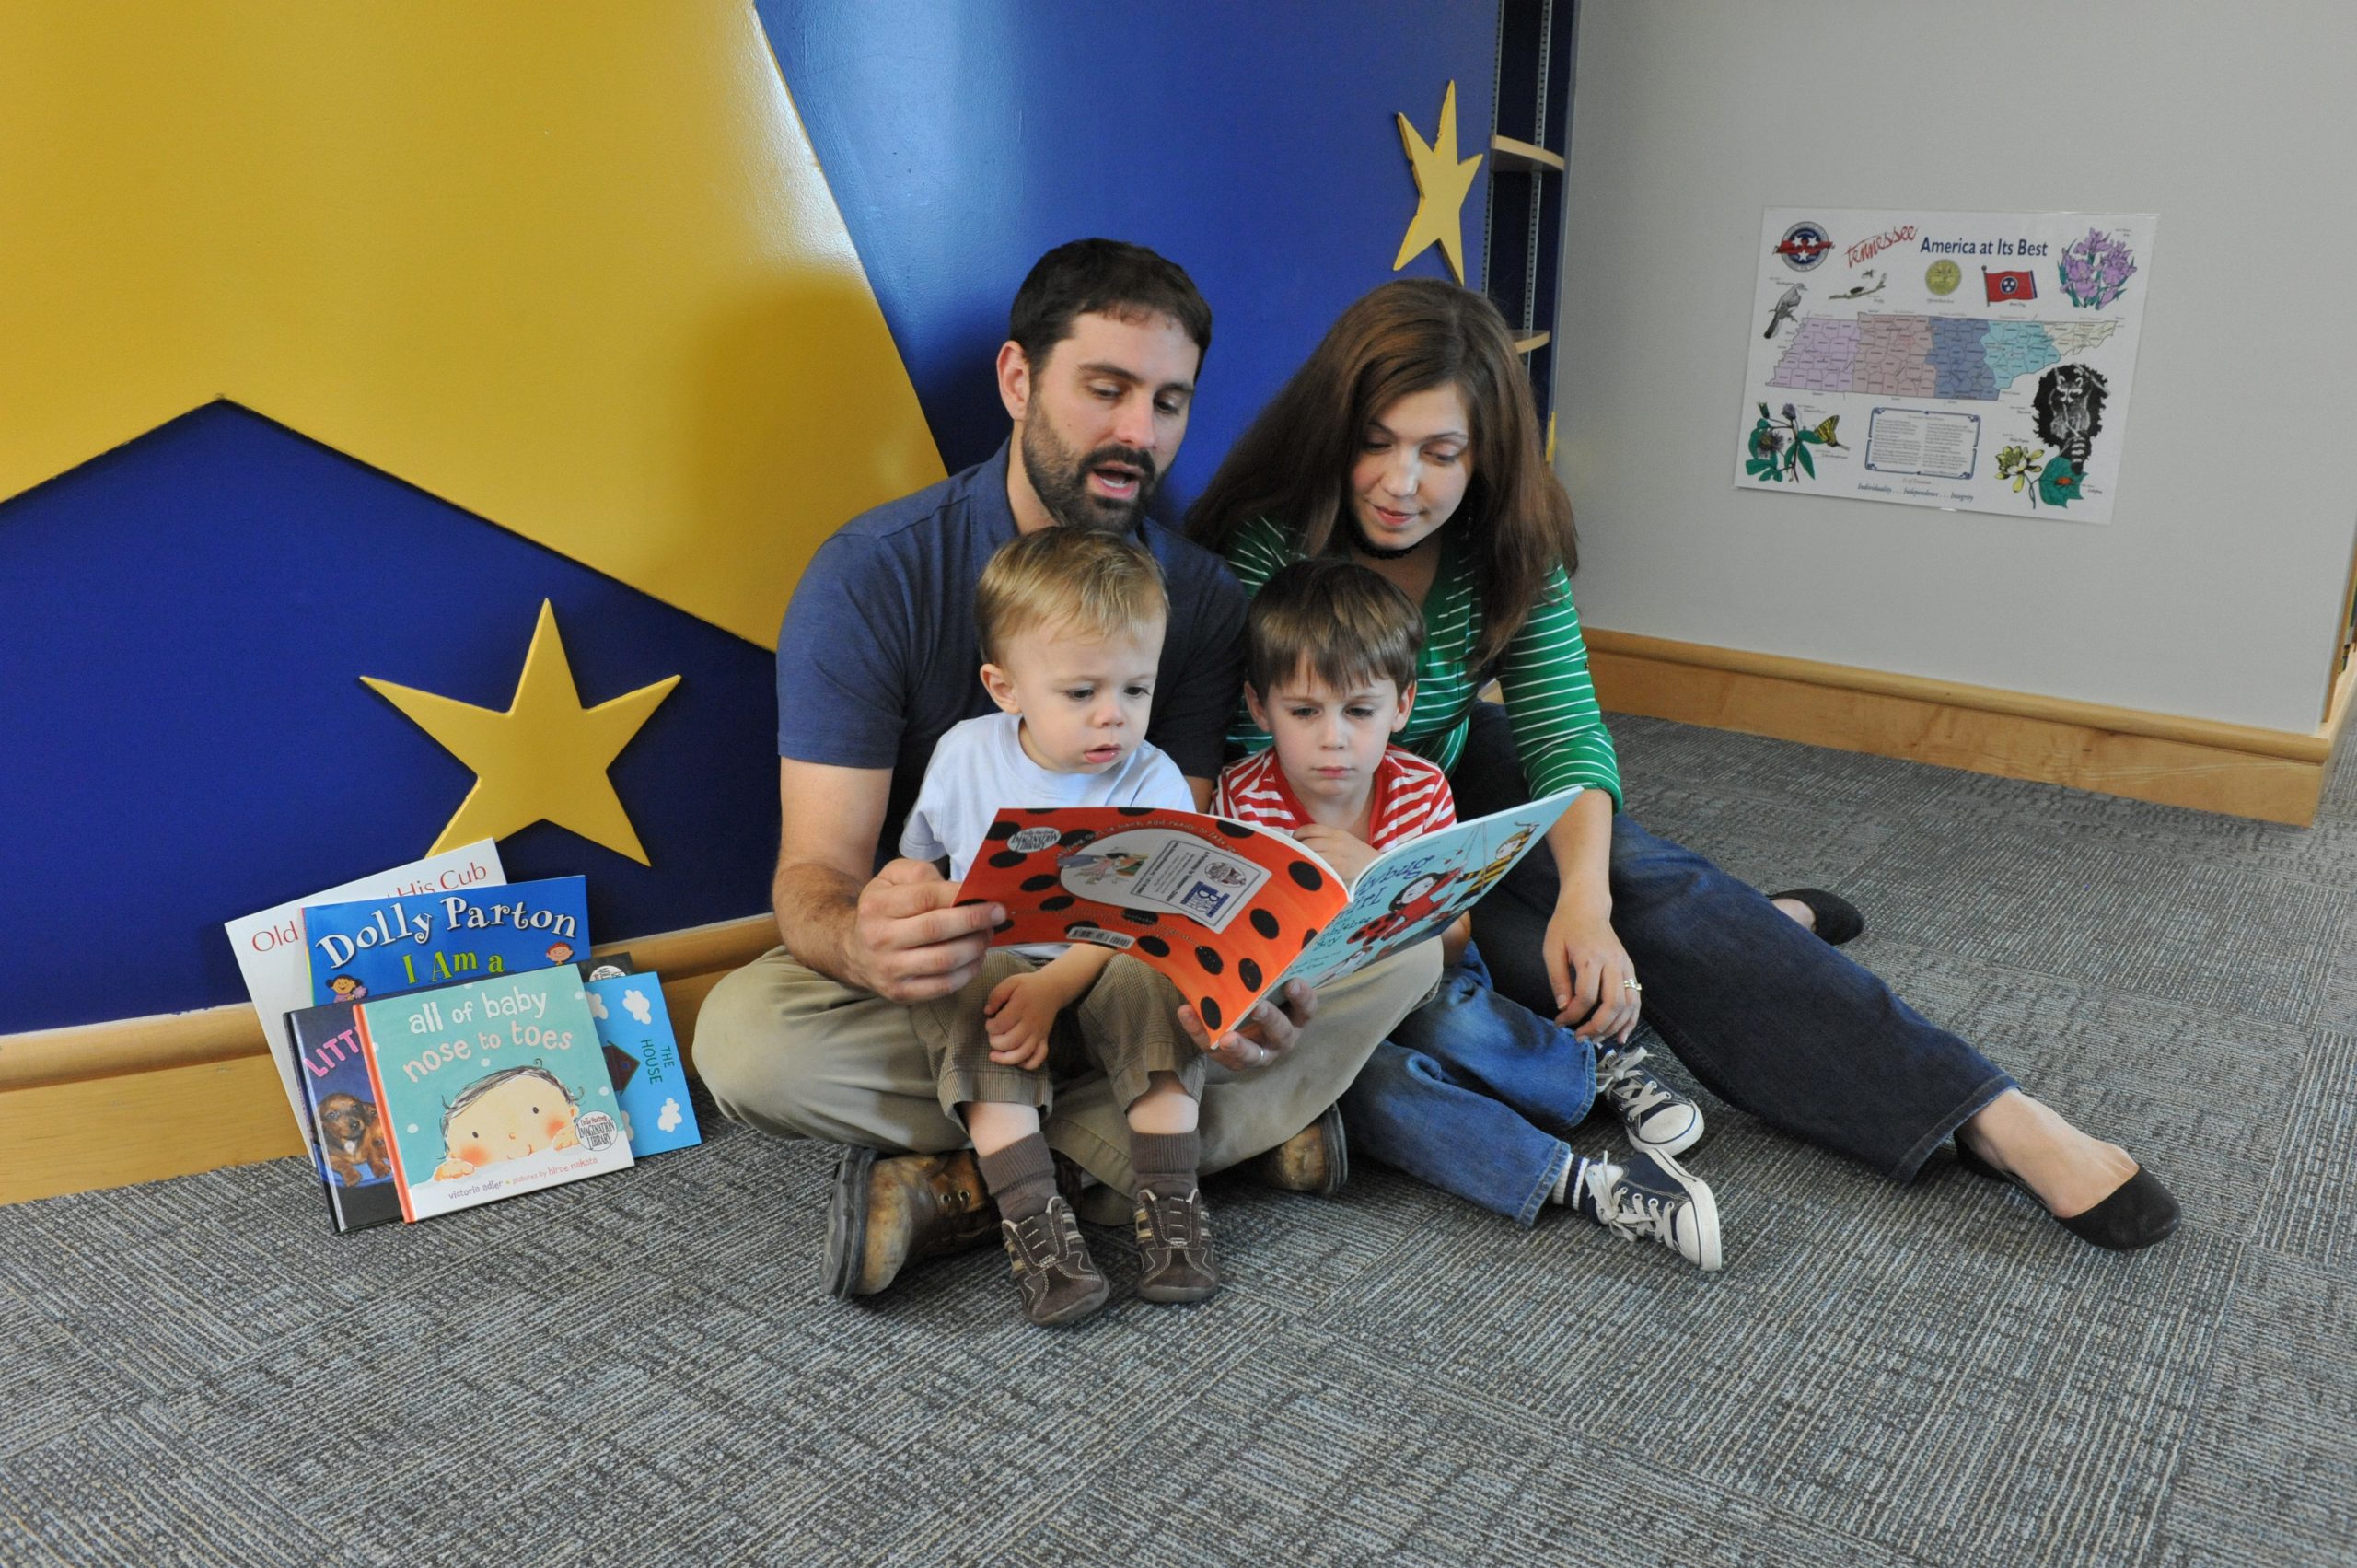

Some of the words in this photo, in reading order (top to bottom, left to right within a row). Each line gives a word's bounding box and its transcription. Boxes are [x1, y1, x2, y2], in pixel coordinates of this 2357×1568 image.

[1842, 225, 1918, 268] Tennessee
[1920, 236, 1976, 254] America
[1980, 241, 1993, 255] at
[1997, 238, 2014, 255] Its
[2017, 239, 2048, 256] Best
[397, 880, 435, 897] His
[440, 862, 486, 890] Cub
[251, 922, 298, 952] Old
[315, 902, 433, 970] Dolly
[440, 896, 577, 939] Parton
[401, 954, 418, 984] I
[428, 951, 479, 983] Am
[487, 954, 505, 973] a
[408, 1001, 444, 1034] all
[451, 1000, 473, 1024] of
[481, 985, 547, 1019] baby
[304, 1026, 361, 1077] LITT
[402, 1040, 471, 1083] nose
[478, 1031, 501, 1050] to
[511, 1020, 573, 1050] toes
[640, 1039, 663, 1085] HOUSE
[659, 1045, 675, 1069] THE
[448, 1184, 480, 1199] victoria
[482, 1180, 504, 1191] adler
[571, 1156, 598, 1170] nakata
